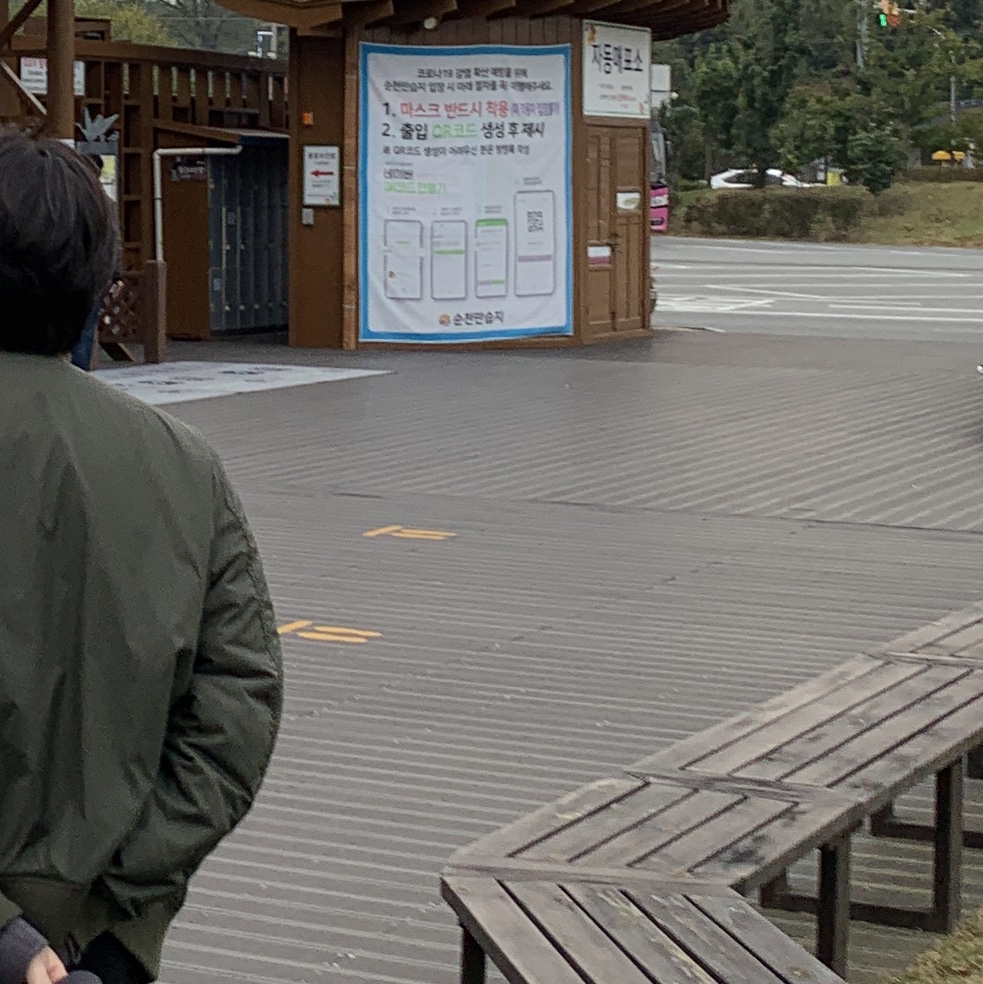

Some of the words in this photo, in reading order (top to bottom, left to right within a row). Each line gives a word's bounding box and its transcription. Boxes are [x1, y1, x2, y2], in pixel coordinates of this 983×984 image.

[592, 43, 643, 74] 자동매표소
[382, 102, 396, 117] 1.
[400, 101, 441, 118] 마스크
[444, 101, 482, 119] 반드시
[485, 100, 509, 118] 착용
[381, 122, 396, 137] 2.
[400, 122, 428, 140] 출입
[432, 123, 477, 140] QR코드
[480, 121, 505, 139] 생성
[507, 121, 519, 138] 후
[521, 121, 545, 138] 제시
[453, 310, 504, 326] 순천만습지
